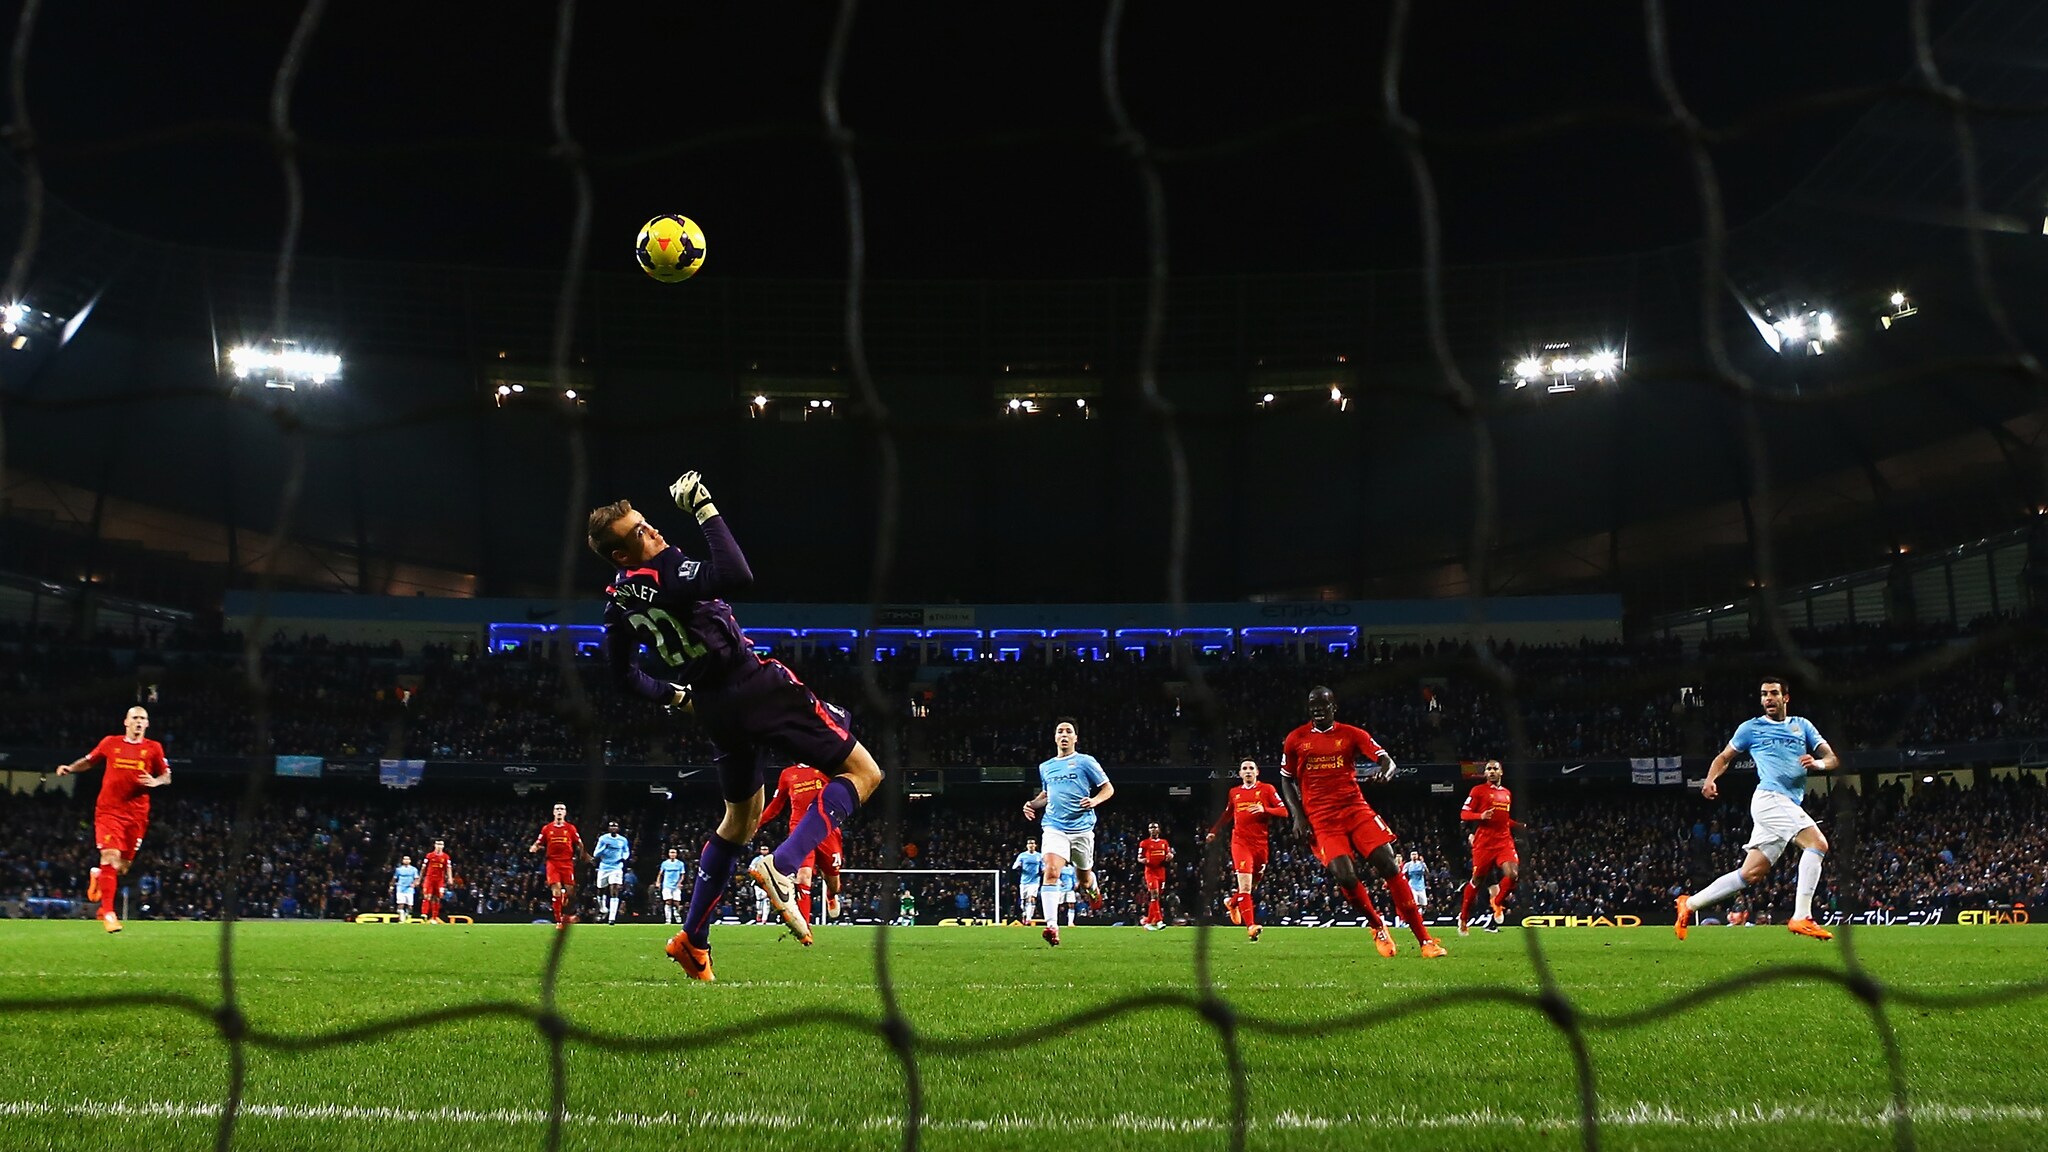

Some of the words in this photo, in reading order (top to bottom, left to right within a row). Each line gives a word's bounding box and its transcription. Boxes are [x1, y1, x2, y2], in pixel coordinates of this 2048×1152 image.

[1262, 603, 1351, 618] ETIHAD
[628, 607, 708, 667] 22
[1521, 915, 1642, 928] ETIHAD
[1957, 910, 2029, 925] ETIHAD
